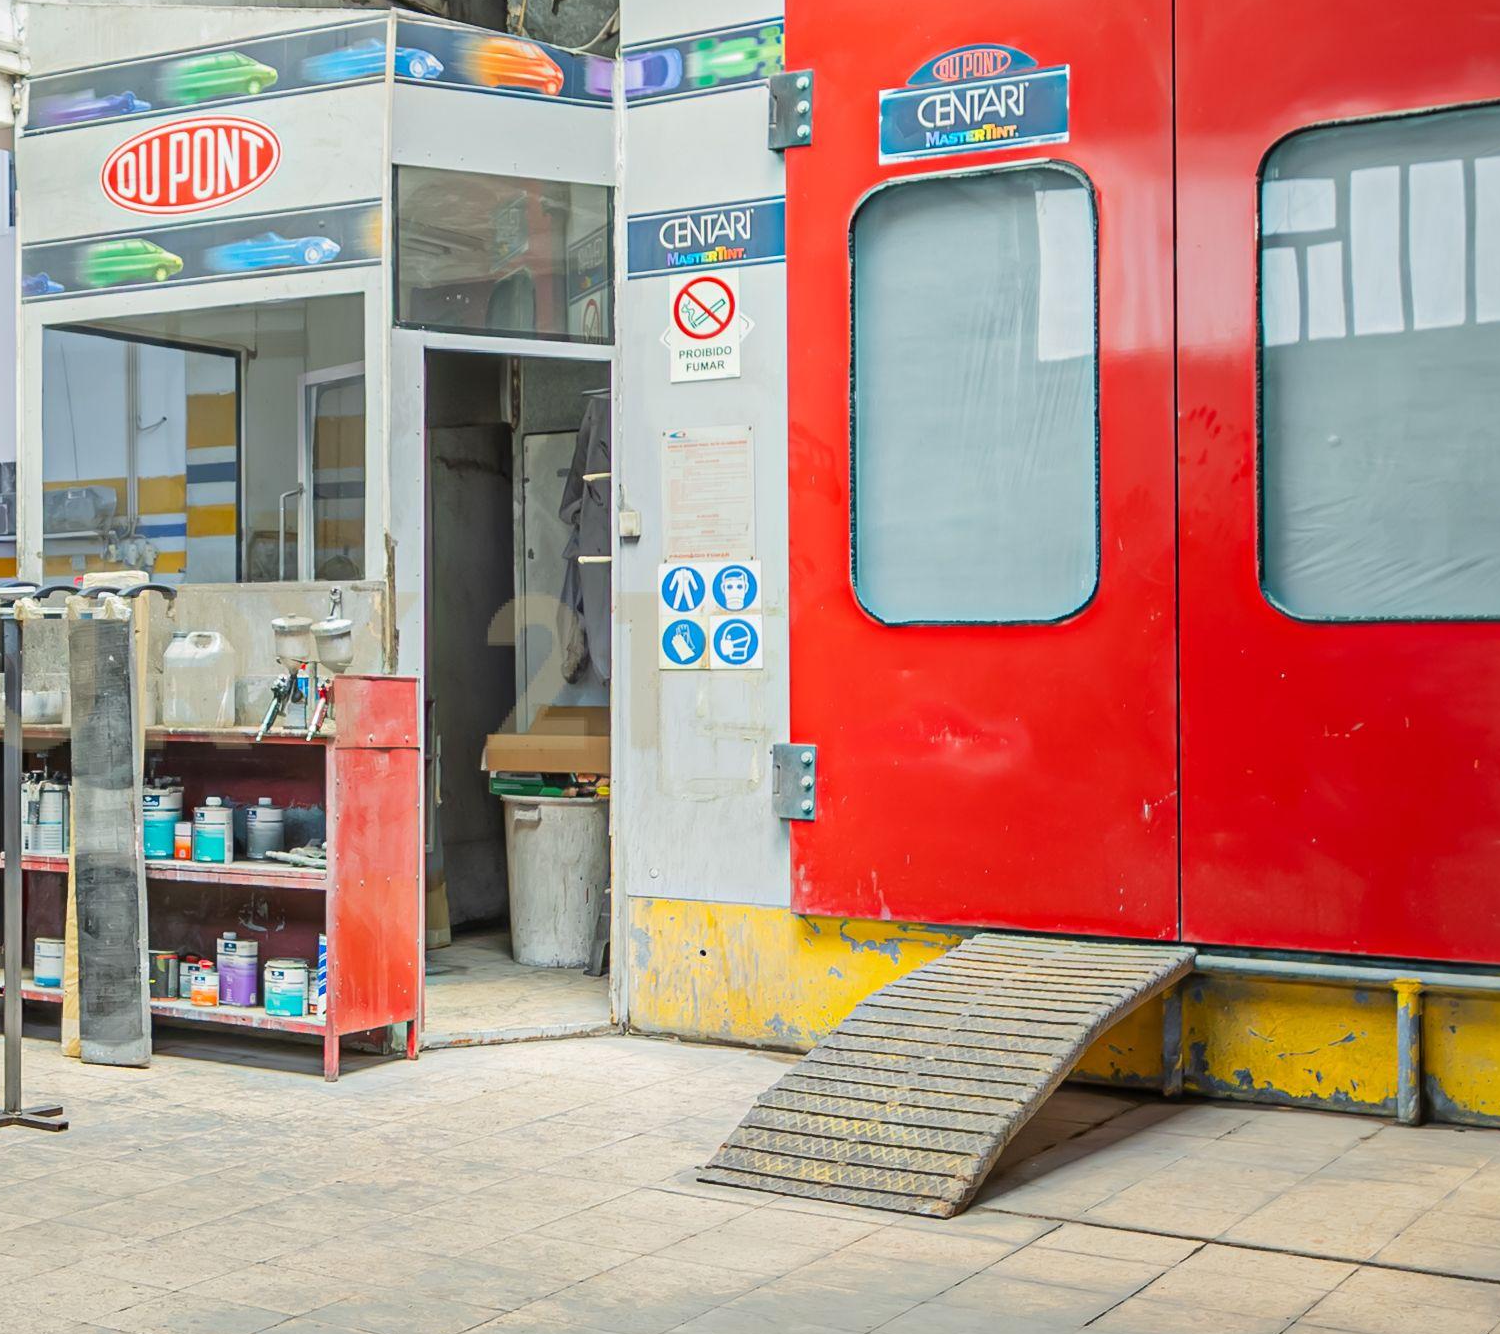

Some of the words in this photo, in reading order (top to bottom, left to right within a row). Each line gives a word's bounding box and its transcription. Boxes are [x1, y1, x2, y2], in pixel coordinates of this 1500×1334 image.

[939, 55, 960, 79] DU
[963, 51, 1004, 80] PONT
[917, 82, 1026, 129] CENTARI
[117, 138, 160, 204] DU
[169, 128, 265, 204] PONT
[659, 208, 751, 249] CENTARI
[678, 345, 732, 359] PROIBIDO
[686, 360, 725, 372] FUMAR
